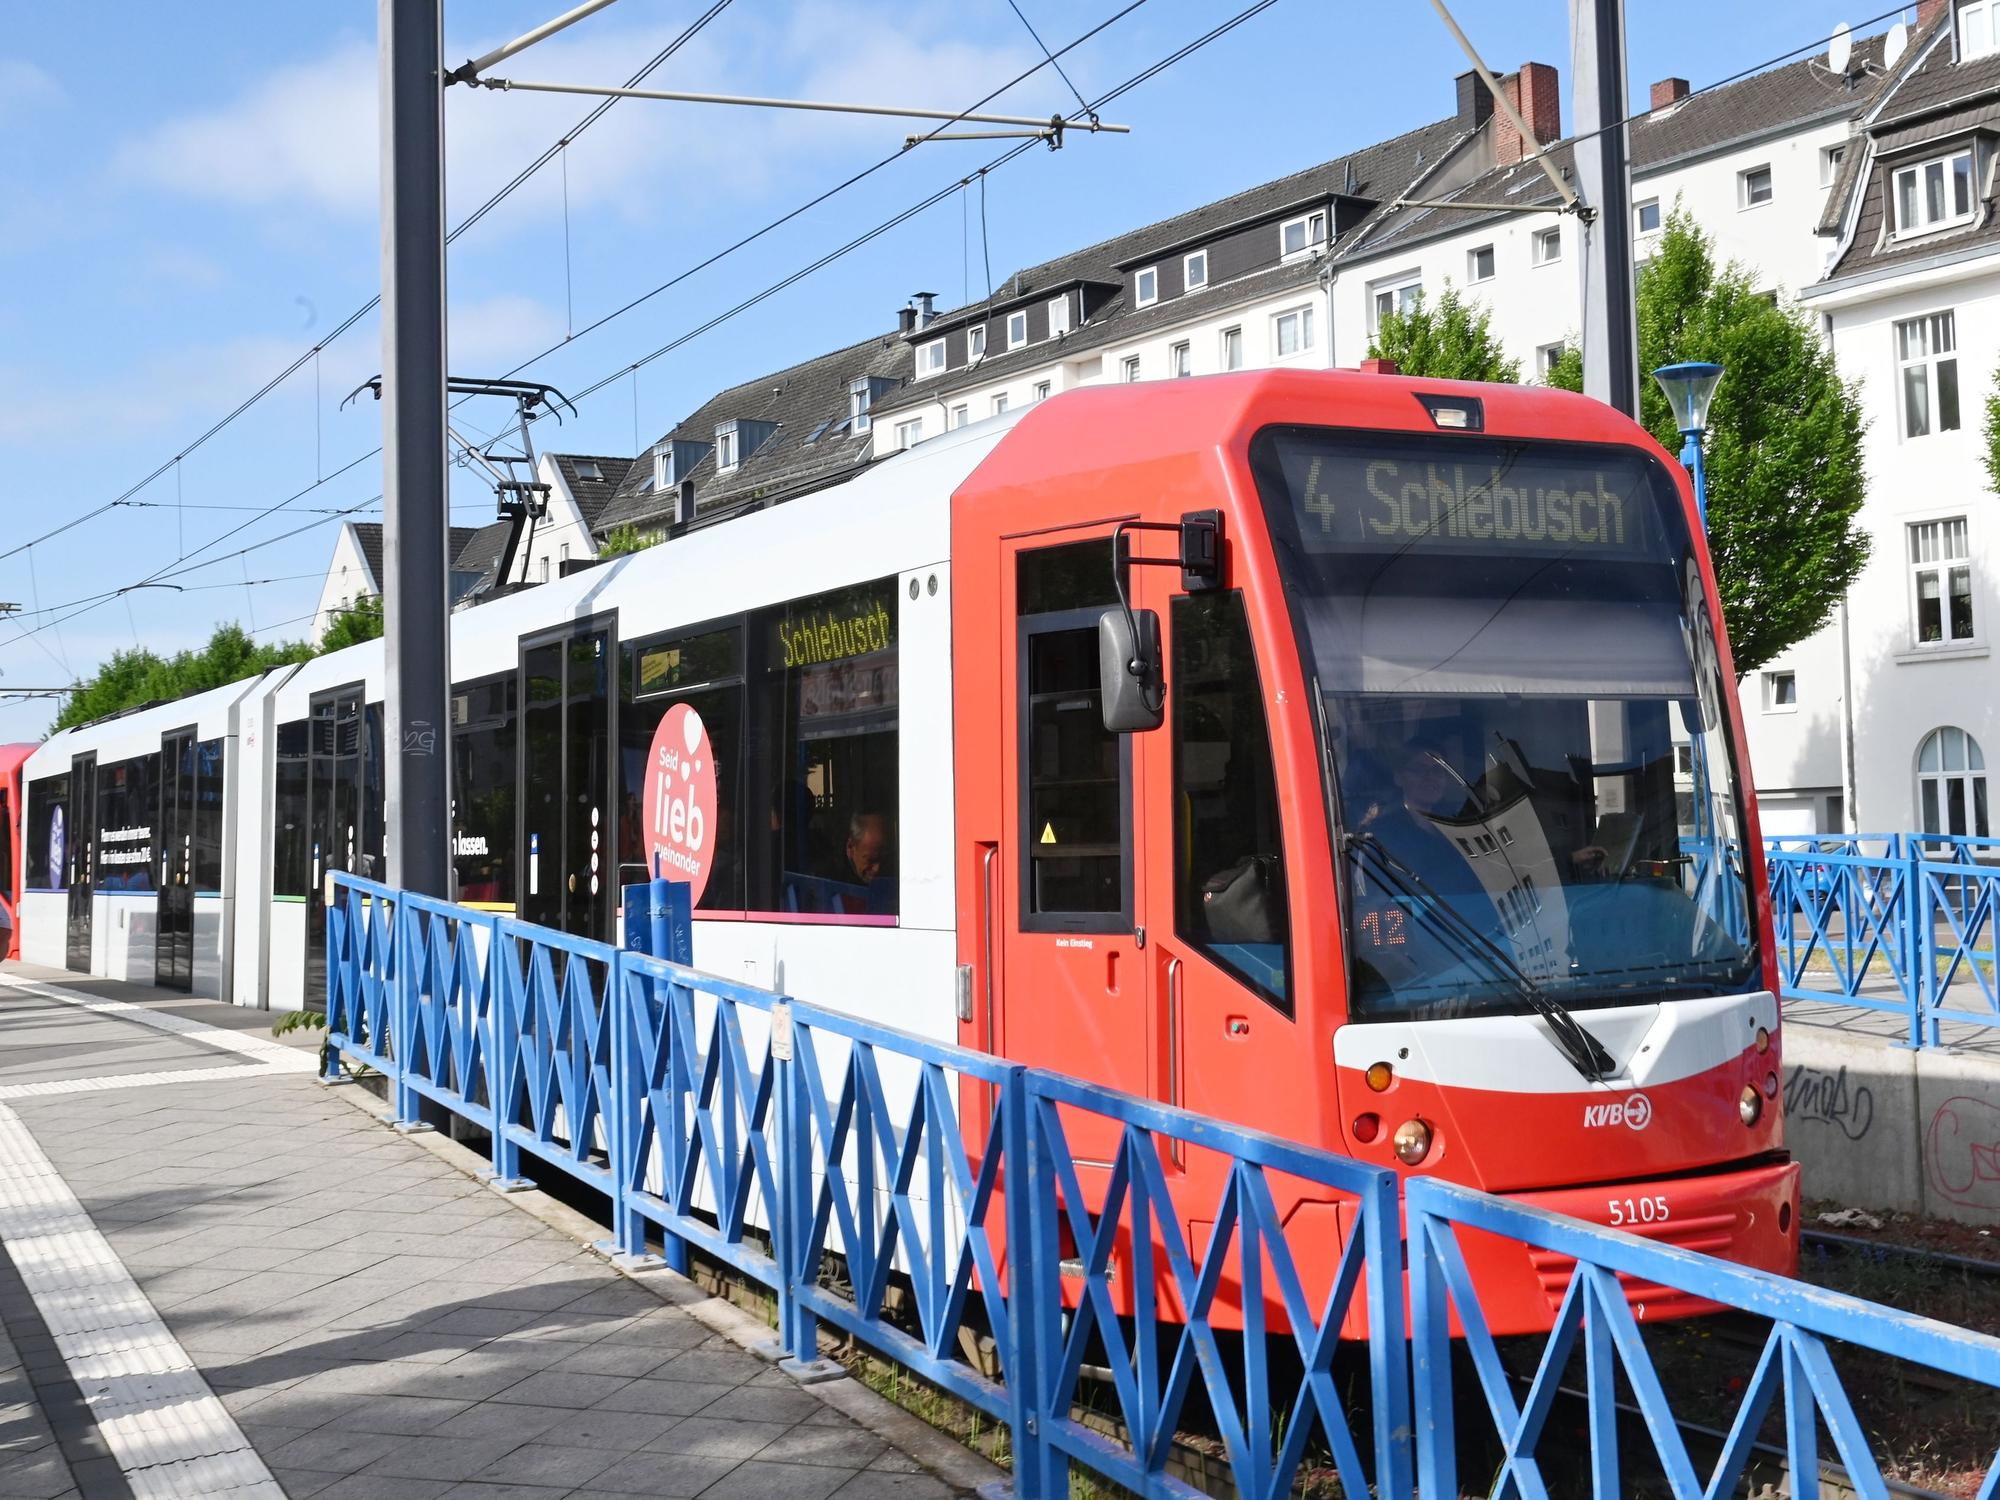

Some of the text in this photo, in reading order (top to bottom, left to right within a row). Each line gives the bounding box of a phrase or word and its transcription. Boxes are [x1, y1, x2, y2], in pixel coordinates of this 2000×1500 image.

[1304, 456, 1625, 545] 4 Schlebusch
[779, 600, 890, 668] Schlebusch
[659, 746, 679, 772] Seid
[655, 771, 704, 852] lieb
[654, 841, 701, 876] zueinander
[1056, 938, 1093, 949] Kein Einstieg
[1360, 910, 1406, 947] 12
[1583, 1103, 1623, 1128] KVB
[1608, 1196, 1670, 1226] 5105
